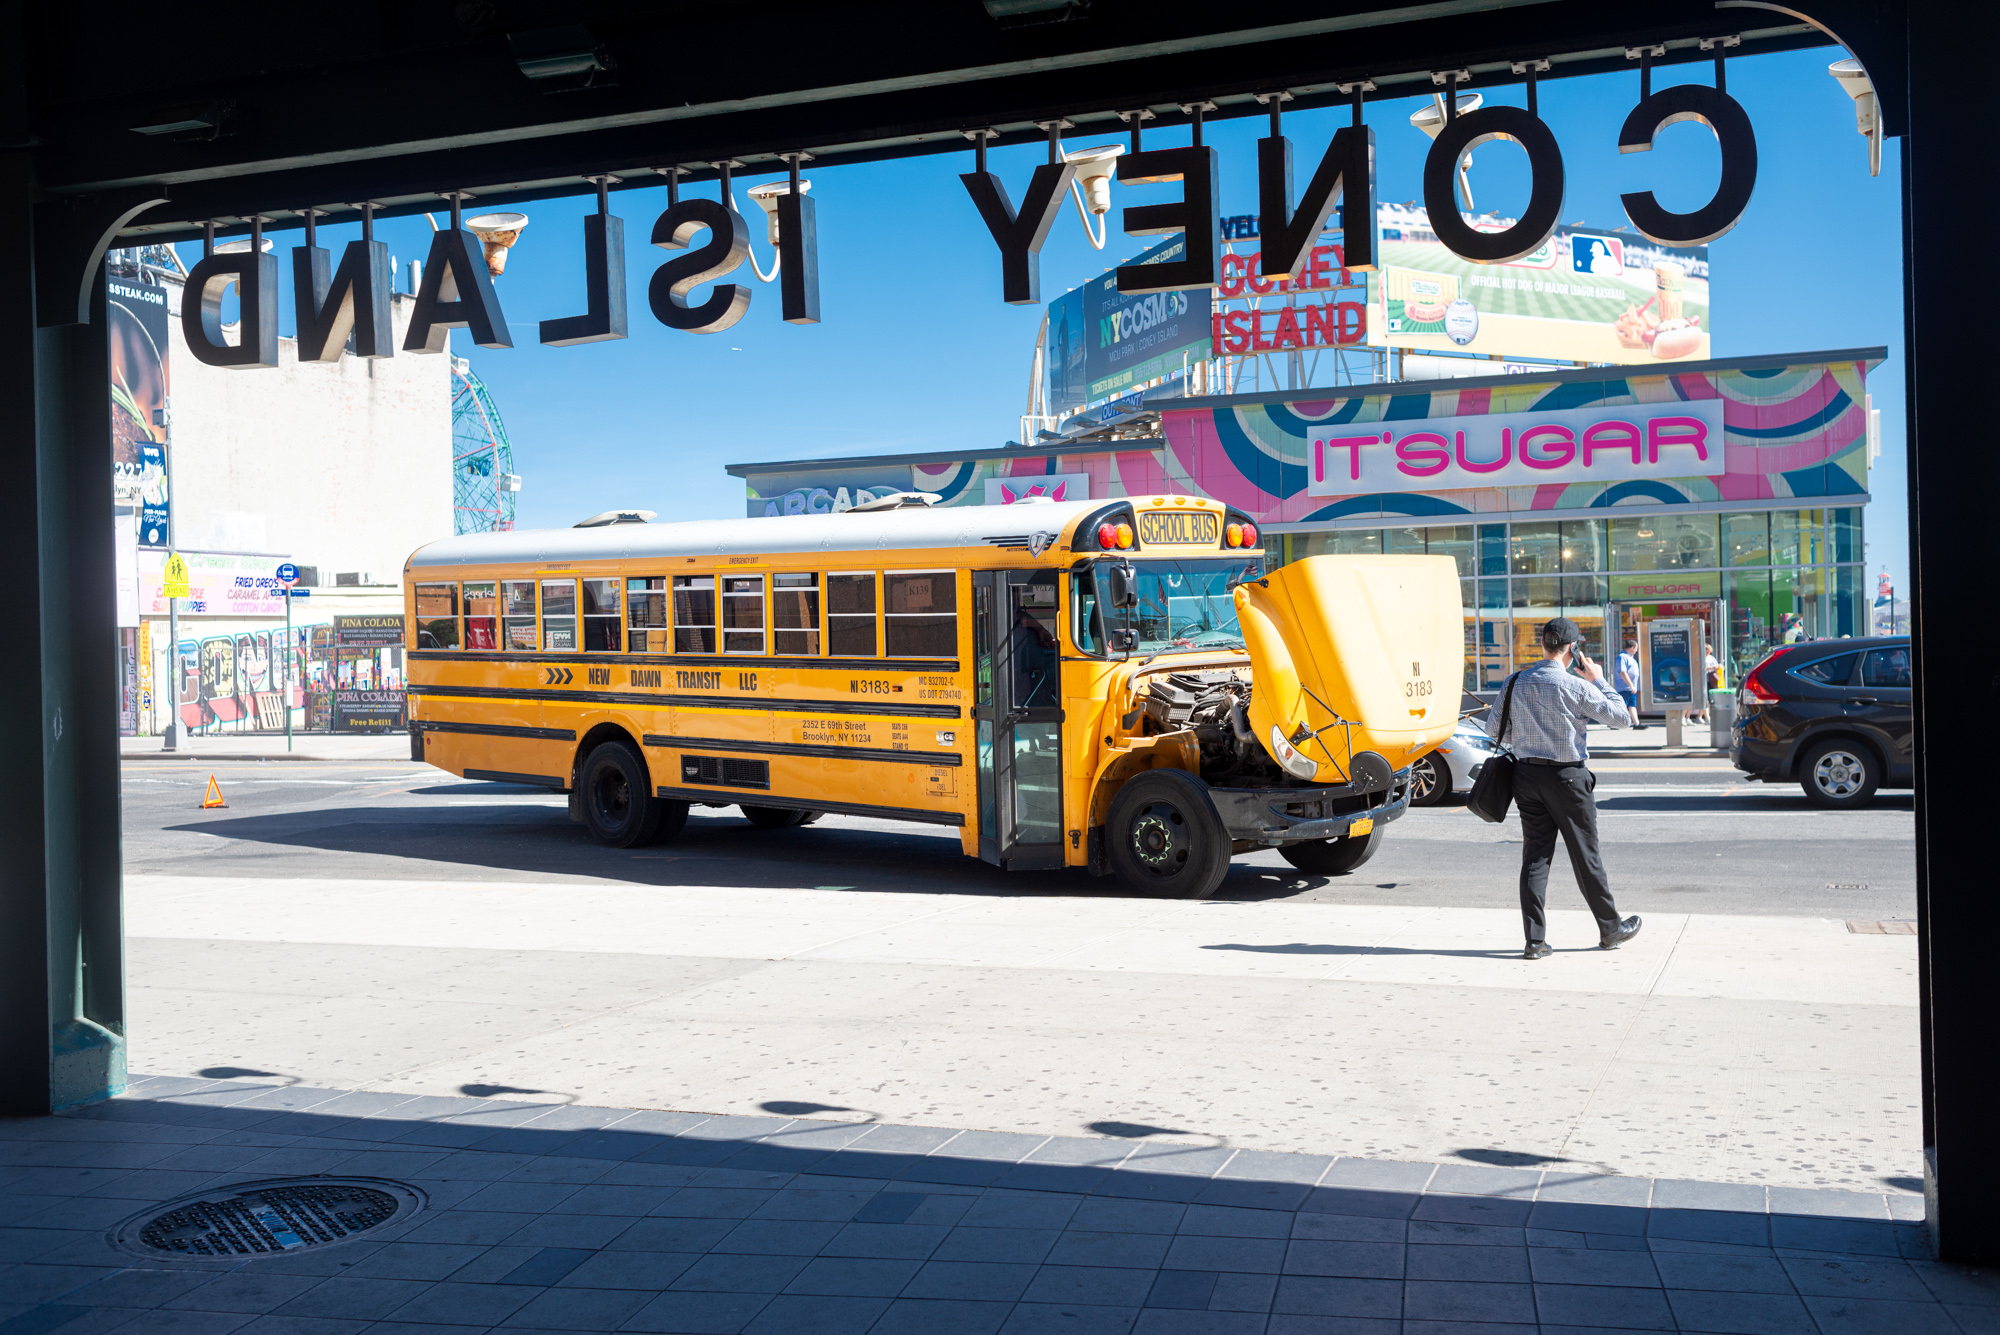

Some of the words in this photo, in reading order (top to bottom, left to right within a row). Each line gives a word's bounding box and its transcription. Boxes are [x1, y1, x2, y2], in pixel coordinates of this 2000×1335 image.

[1160, 242, 1184, 261] COUNTRY
[1471, 275, 1500, 287] OFFICIAL
[1502, 278, 1516, 289] HOT
[1518, 280, 1533, 291] DOG
[1534, 282, 1544, 292] OF
[1545, 283, 1569, 295] MAJOR
[1570, 285, 1594, 297] LEAGUE
[1595, 287, 1626, 300] BASEBALL
[1212, 301, 1367, 354] ISLAND
[1109, 350, 1121, 363] MCU
[1121, 346, 1135, 359] PARK
[1139, 336, 1156, 351] CONEY
[1157, 325, 1178, 343] ISLAND
[1092, 380, 1107, 395] TICKETS
[1113, 374, 1123, 387] SALE
[1314, 416, 1709, 483] IT'SUGAR
[764, 486, 878, 516] ARCAD
[1142, 514, 1189, 542] SCHOOL
[1191, 514, 1214, 542] BUS
[189, 553, 236, 569] Cream
[241, 556, 275, 572] Shop
[143, 573, 165, 586] FRES
[234, 576, 253, 588] FRIED
[255, 577, 279, 589] OREO'S
[166, 587, 187, 595] AHEAD
[189, 588, 205, 599] PPLE
[227, 588, 261, 600] CARAMEL
[909, 585, 929, 595] K139
[1628, 584, 1701, 595] IT'SUGAR
[152, 600, 170, 612] SLUS
[178, 601, 208, 613] PUPPIES
[232, 602, 259, 613] COTTON
[260, 602, 283, 614] CANDY
[341, 618, 362, 628] PINA
[363, 618, 400, 627] COLADA
[588, 668, 610, 685] NEW
[630, 669, 661, 687] DAWN
[676, 671, 721, 690] TRANSIT
[739, 672, 758, 691] LLC
[919, 676, 927, 686] MC
[928, 676, 954, 687] 932702-C
[860, 679, 890, 694] 3183
[1405, 680, 1433, 697] 3183
[361, 692, 403, 702] COLADA
[919, 689, 927, 699] US
[927, 690, 938, 699] DOT
[938, 690, 962, 700] 2794740
[802, 720, 819, 729] 2352
[821, 720, 826, 729] E
[827, 720, 843, 730] 69th
[844, 721, 867, 730] Street
[803, 732, 837, 743] Brooklyn,
[838, 733, 849, 742] NY
[851, 734, 871, 743] 11234
[944, 733, 954, 741] CE
[892, 742, 903, 750] STAND
